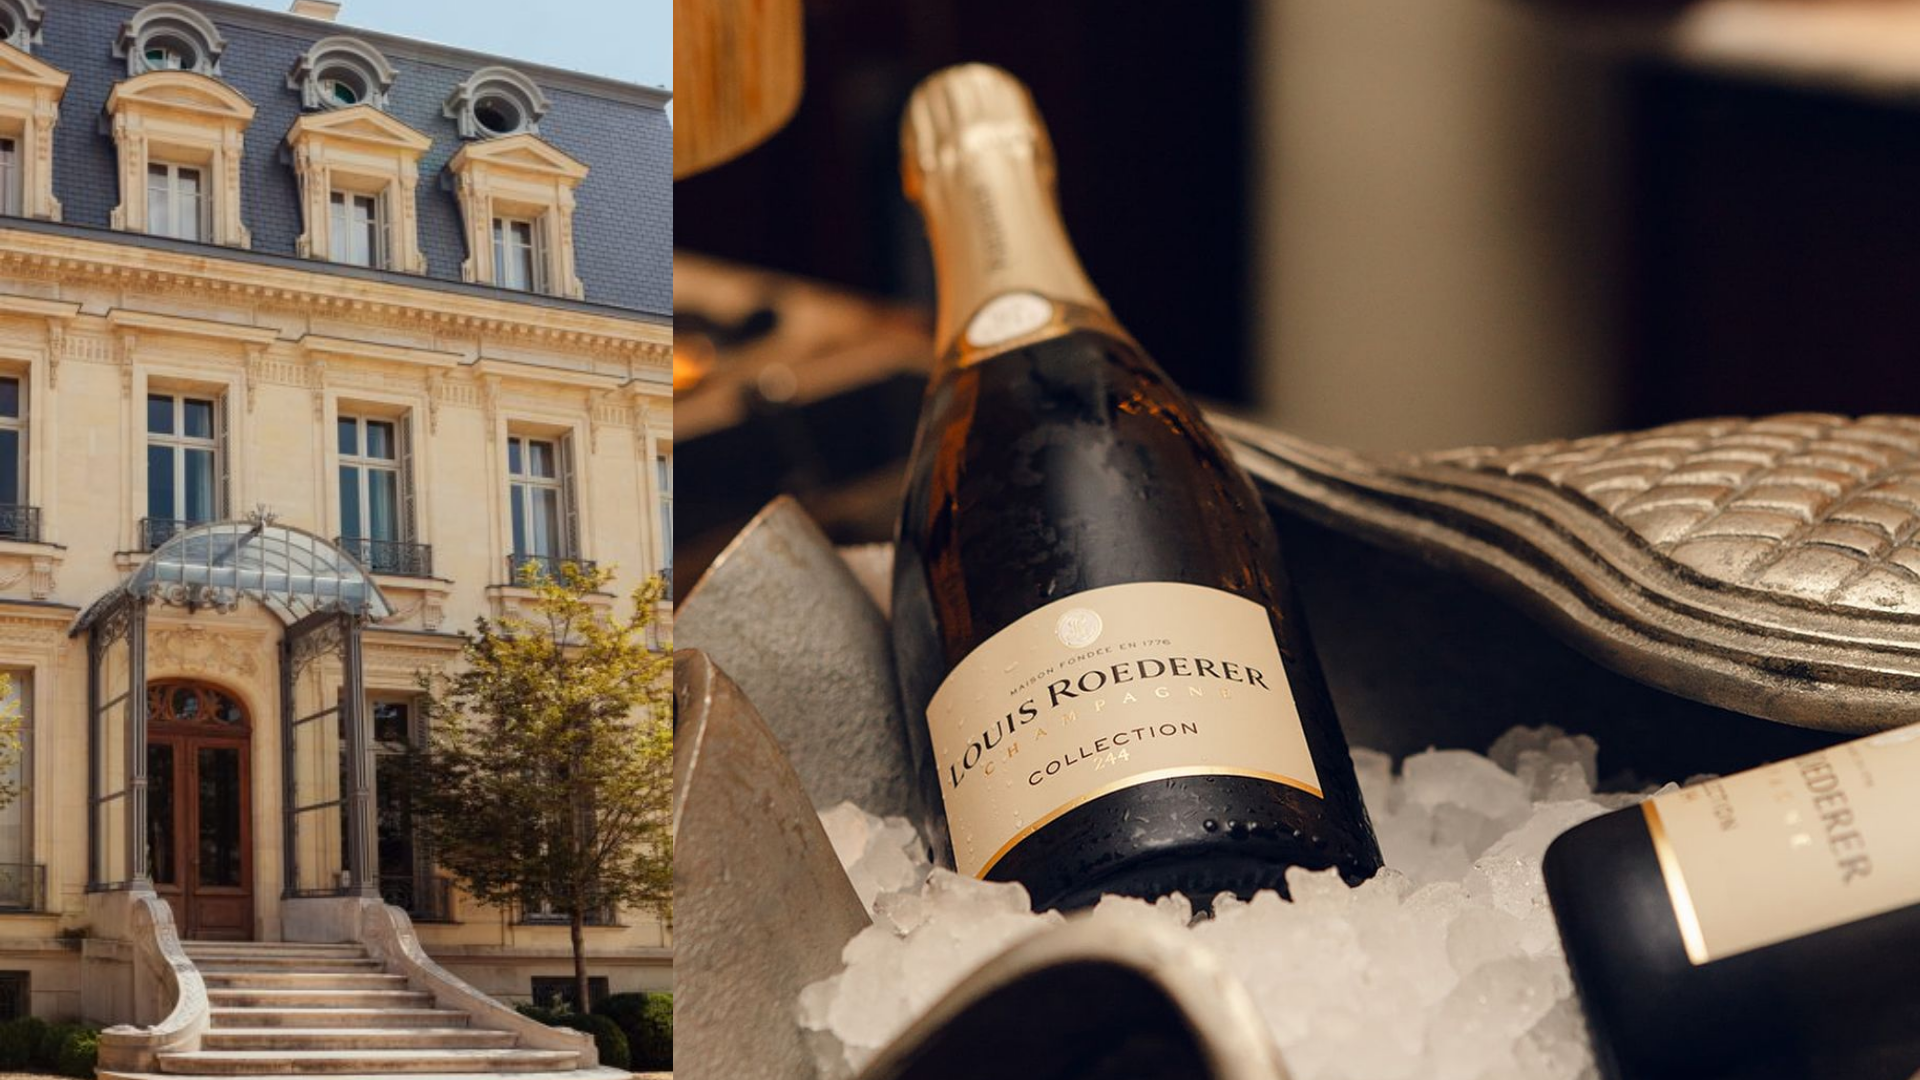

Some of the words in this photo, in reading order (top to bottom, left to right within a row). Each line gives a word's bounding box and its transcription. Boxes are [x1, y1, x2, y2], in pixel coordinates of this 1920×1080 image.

[1010, 667, 1055, 696] MAISON
[1119, 642, 1137, 650] EN
[1142, 638, 1172, 648] 1776
[949, 698, 1038, 789] LOUIS
[1047, 657, 1271, 708] ROEDERER
[983, 685, 1233, 778] CHAMPAGNE
[1028, 721, 1199, 786] COLLECTION
[1092, 747, 1131, 772] 244
